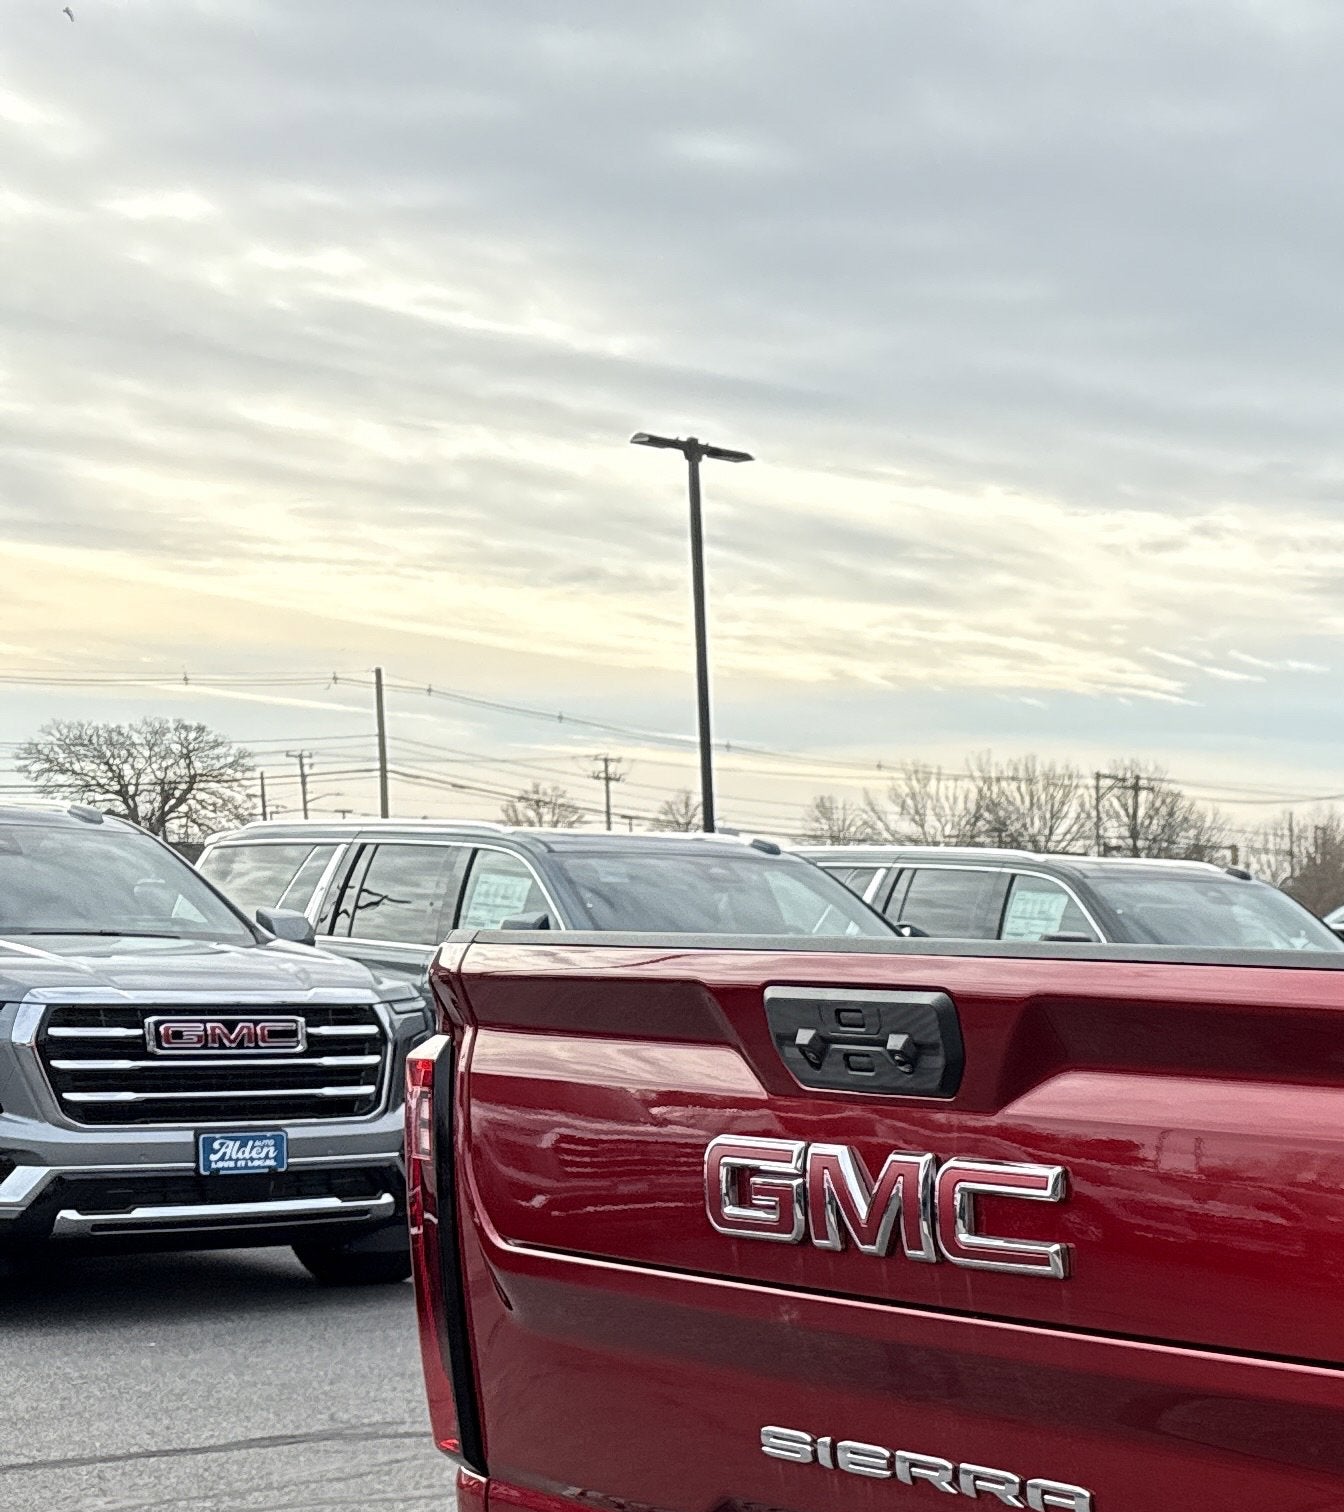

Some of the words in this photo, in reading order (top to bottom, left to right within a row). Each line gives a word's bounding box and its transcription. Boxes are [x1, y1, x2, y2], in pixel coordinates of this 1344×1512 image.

[159, 1022, 299, 1048] GMC
[209, 1139, 279, 1162] Alden
[703, 1133, 1070, 1280] GMC
